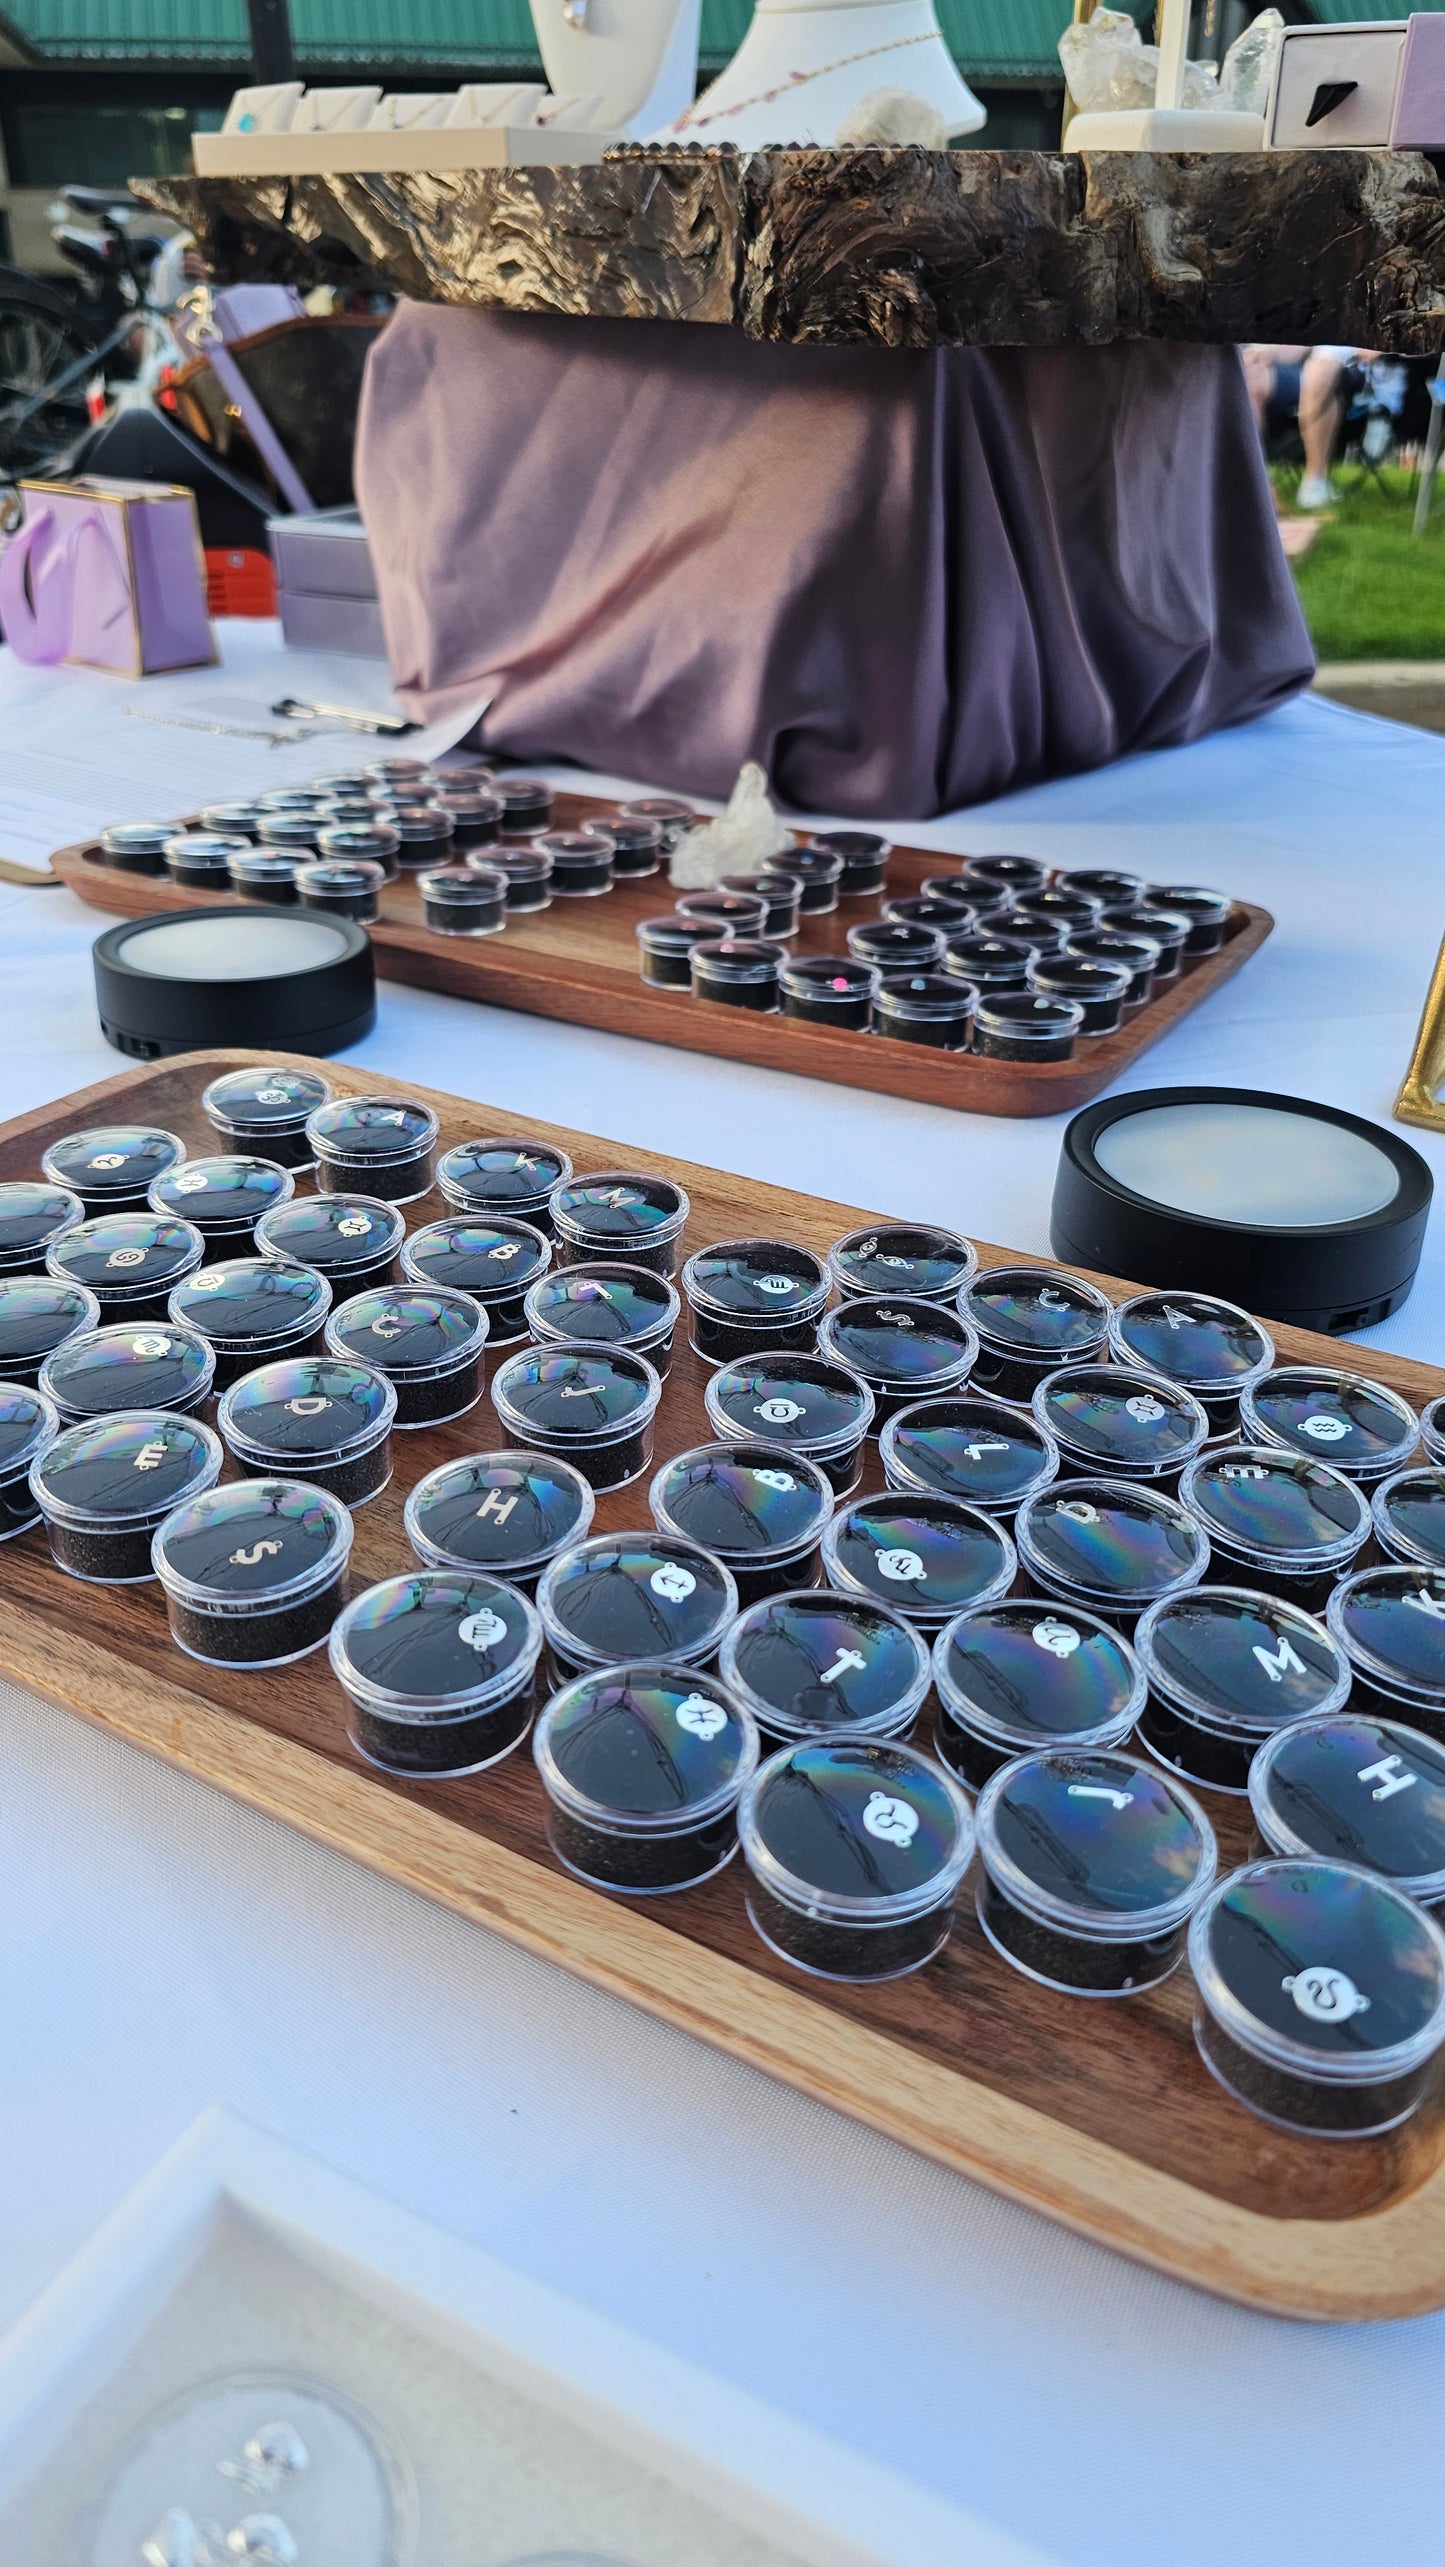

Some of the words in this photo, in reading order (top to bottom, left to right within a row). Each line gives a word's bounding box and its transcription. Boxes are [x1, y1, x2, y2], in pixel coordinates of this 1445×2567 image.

[380, 1109, 407, 1127] A
[514, 1152, 542, 1171] K
[599, 1187, 637, 1209] M
[488, 1243, 521, 1259] B
[579, 1282, 613, 1300] L
[1038, 1288, 1071, 1313] C
[371, 1313, 402, 1338] C
[876, 1310, 915, 1326] S
[1162, 1304, 1197, 1330] A
[284, 1397, 333, 1416] D
[964, 1443, 1010, 1460] L
[752, 1468, 797, 1492] B
[476, 1488, 519, 1525] H
[1056, 1500, 1099, 1525] D
[229, 1539, 284, 1566] S
[1252, 1636, 1307, 1682] M
[1357, 1753, 1417, 1801] H
